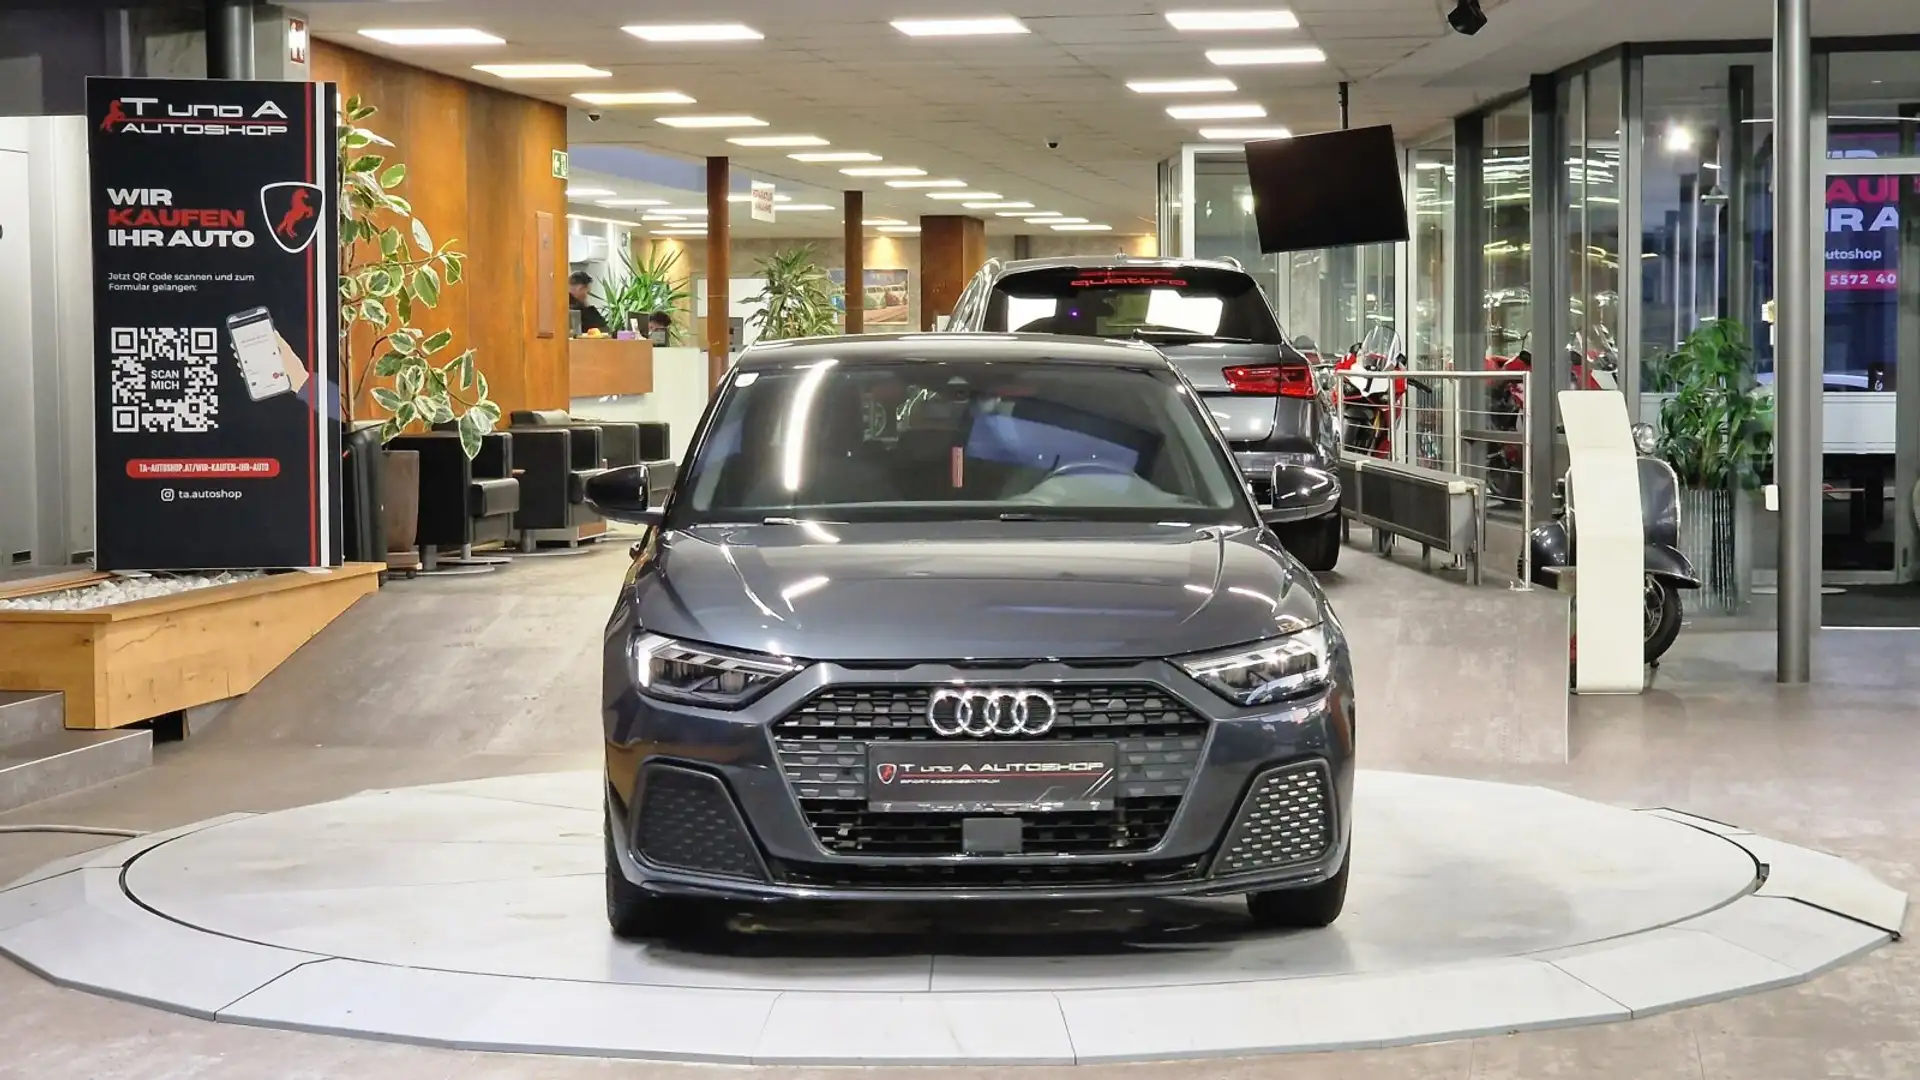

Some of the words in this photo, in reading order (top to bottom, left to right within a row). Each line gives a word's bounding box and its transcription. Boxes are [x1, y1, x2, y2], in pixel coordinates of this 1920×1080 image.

[120, 97, 158, 116] T
[251, 101, 288, 118] A
[121, 123, 288, 136] AUTOSHOP
[107, 188, 173, 206] WIR
[107, 209, 246, 227] KAUFEN
[108, 229, 163, 246] IHR
[169, 230, 255, 248] AUTO
[1825, 247, 1882, 261] utoshop
[108, 272, 131, 280] Jetzt
[132, 272, 147, 281] QR
[148, 272, 173, 280] Code
[1830, 273, 1869, 286] 5572
[1875, 273, 1897, 285] 40
[108, 283, 150, 291] Formular
[152, 283, 198, 292] gelangen:
[1071, 278, 1187, 287] quattro
[151, 369, 180, 380] SCAN
[151, 380, 180, 390] MICH
[139, 462, 270, 473] TA-AUTOSHOP.AT/WIR-KAUFEN-IHR-AUTO
[178, 489, 242, 499] ta.autoshop
[900, 763, 915, 772] T
[958, 763, 973, 772] A
[979, 762, 1104, 773] AUTOSHOP
